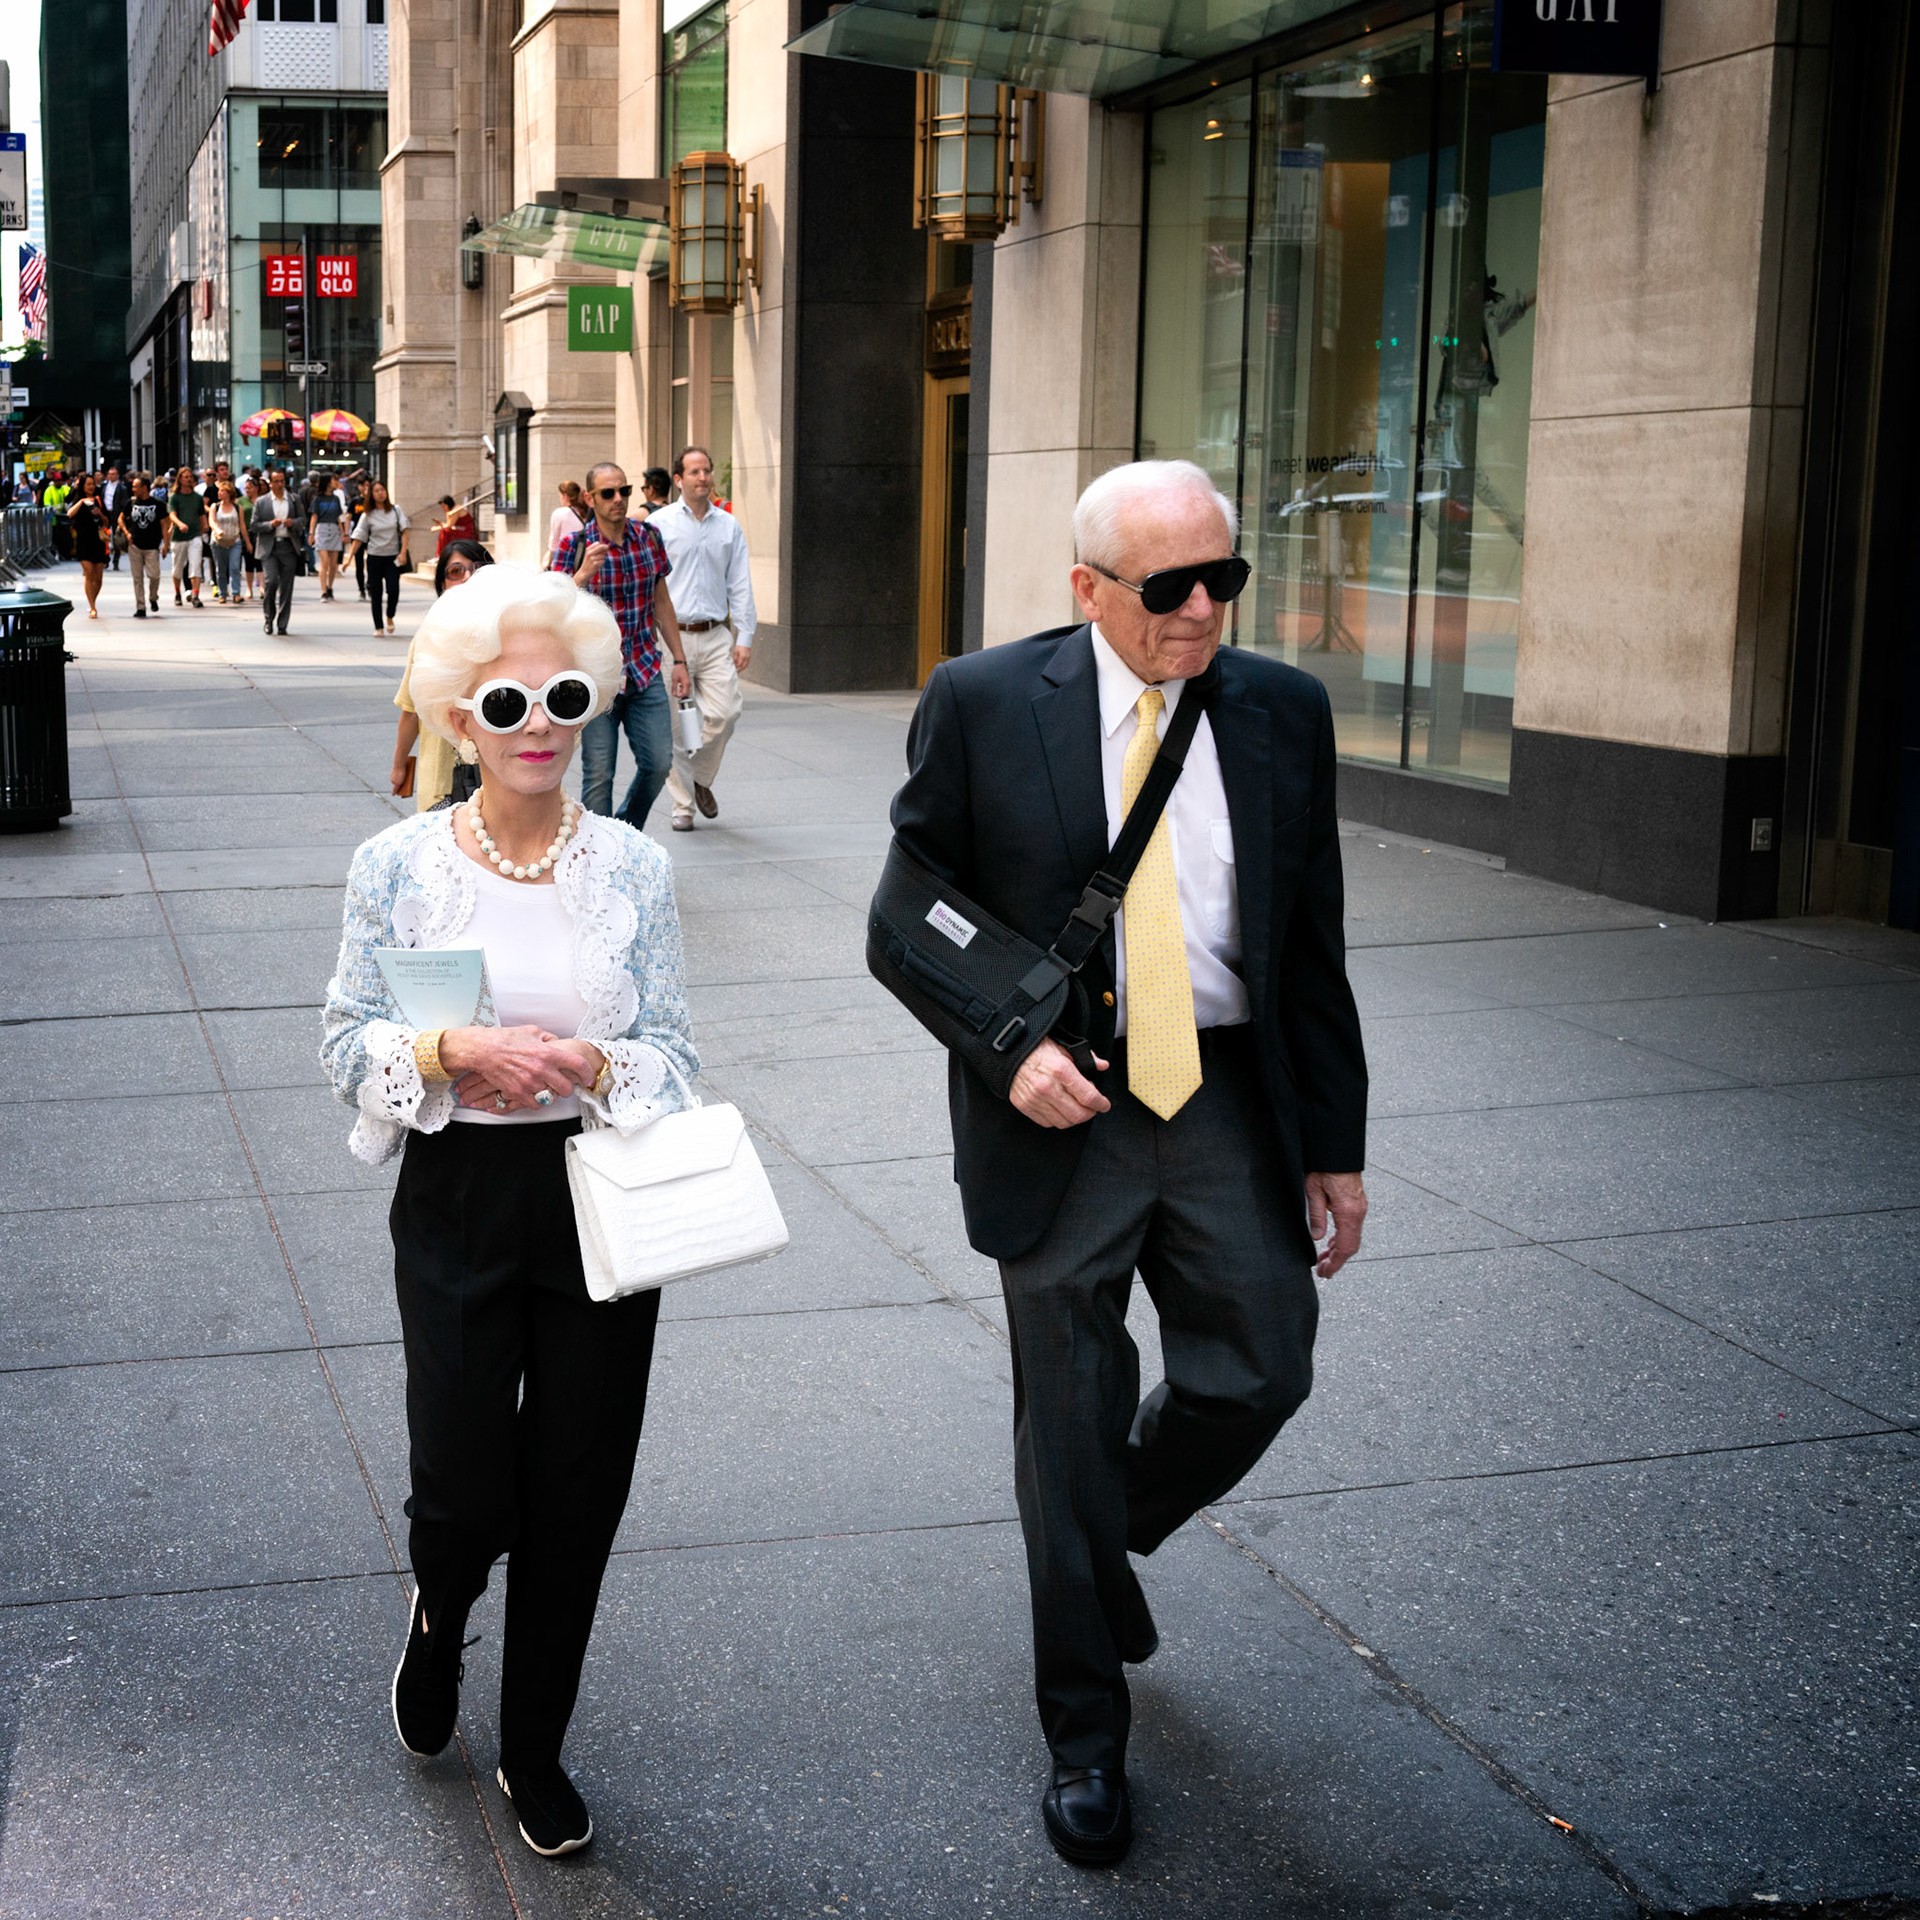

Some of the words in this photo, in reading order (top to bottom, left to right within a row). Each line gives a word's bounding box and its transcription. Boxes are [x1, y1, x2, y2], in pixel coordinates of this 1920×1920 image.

[0, 201, 15, 212] NLY
[1, 214, 23, 226] URNS
[321, 261, 350, 276] UNI
[321, 278, 353, 295] QLO
[581, 304, 620, 334] GAP
[1271, 454, 1302, 473] meet
[945, 917, 968, 937] DYNAMIC
[395, 960, 433, 968] MAGNIFICENT
